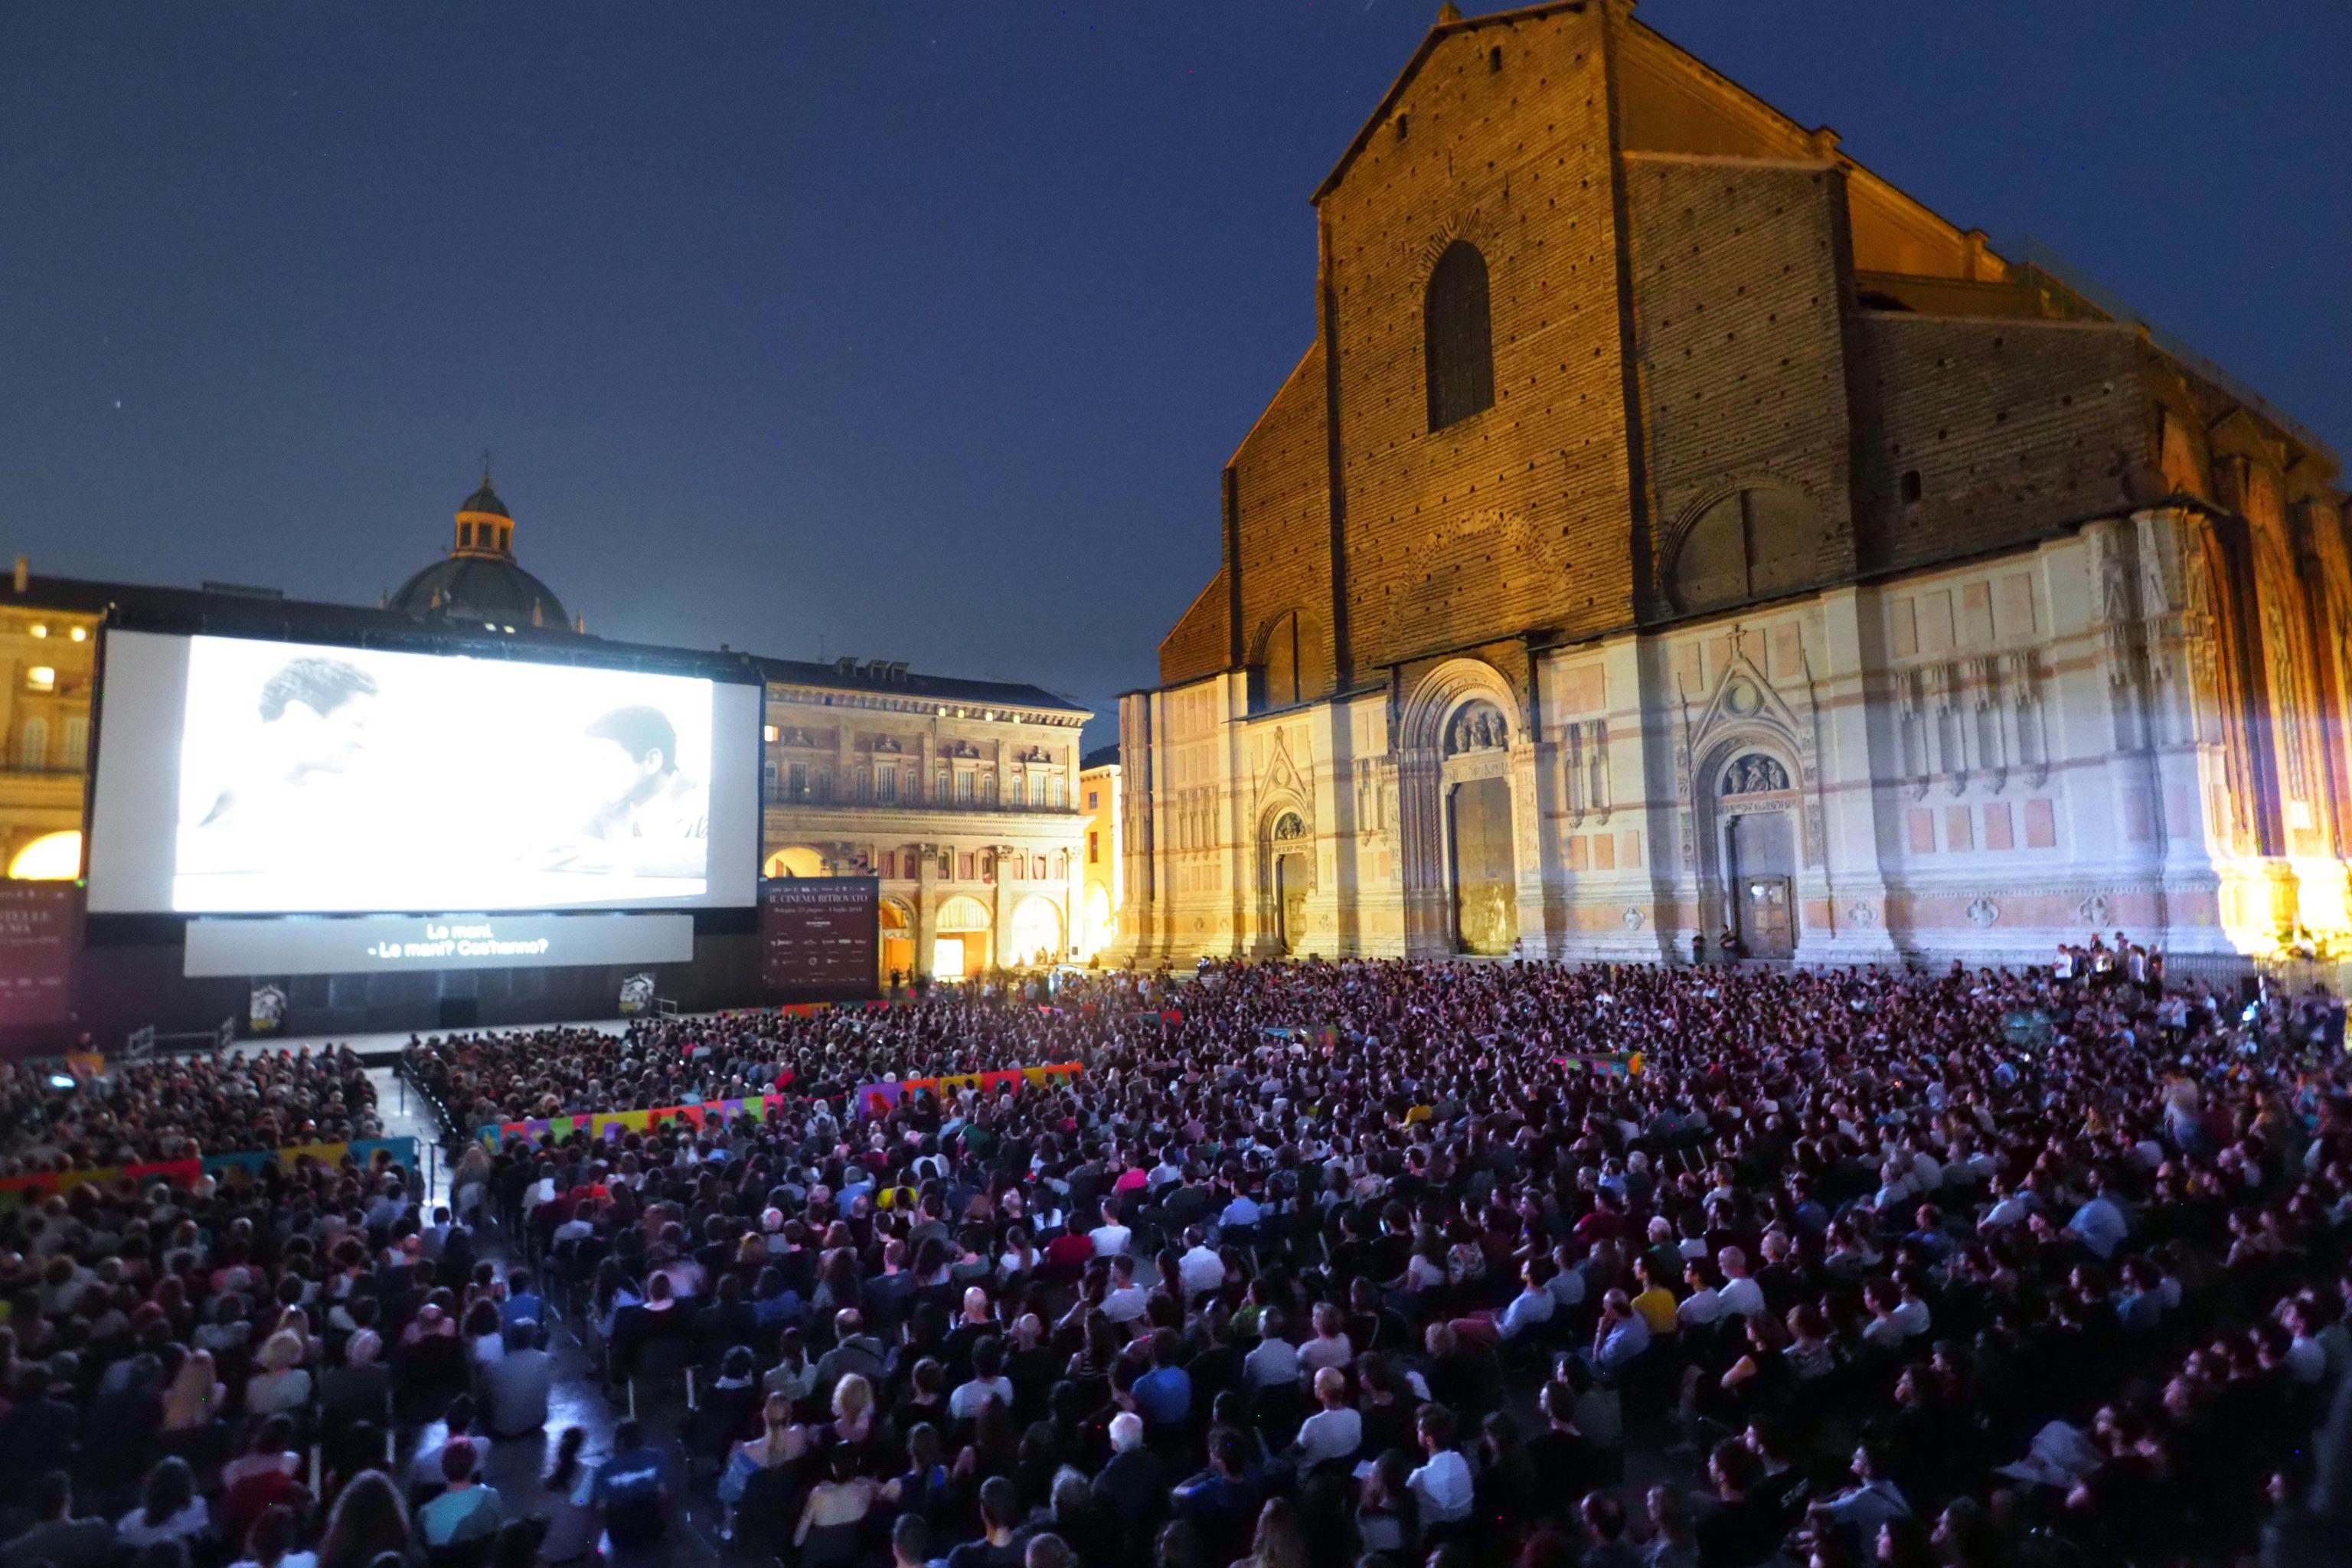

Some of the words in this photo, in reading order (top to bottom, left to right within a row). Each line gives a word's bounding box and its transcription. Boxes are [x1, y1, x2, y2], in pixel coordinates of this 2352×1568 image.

[780, 894, 817, 903] CINEMA
[818, 893, 868, 903] RITROVATO
[426, 923, 449, 940] Le
[451, 923, 494, 939] mani.
[379, 942, 402, 958] Le
[404, 939, 456, 957] mani?
